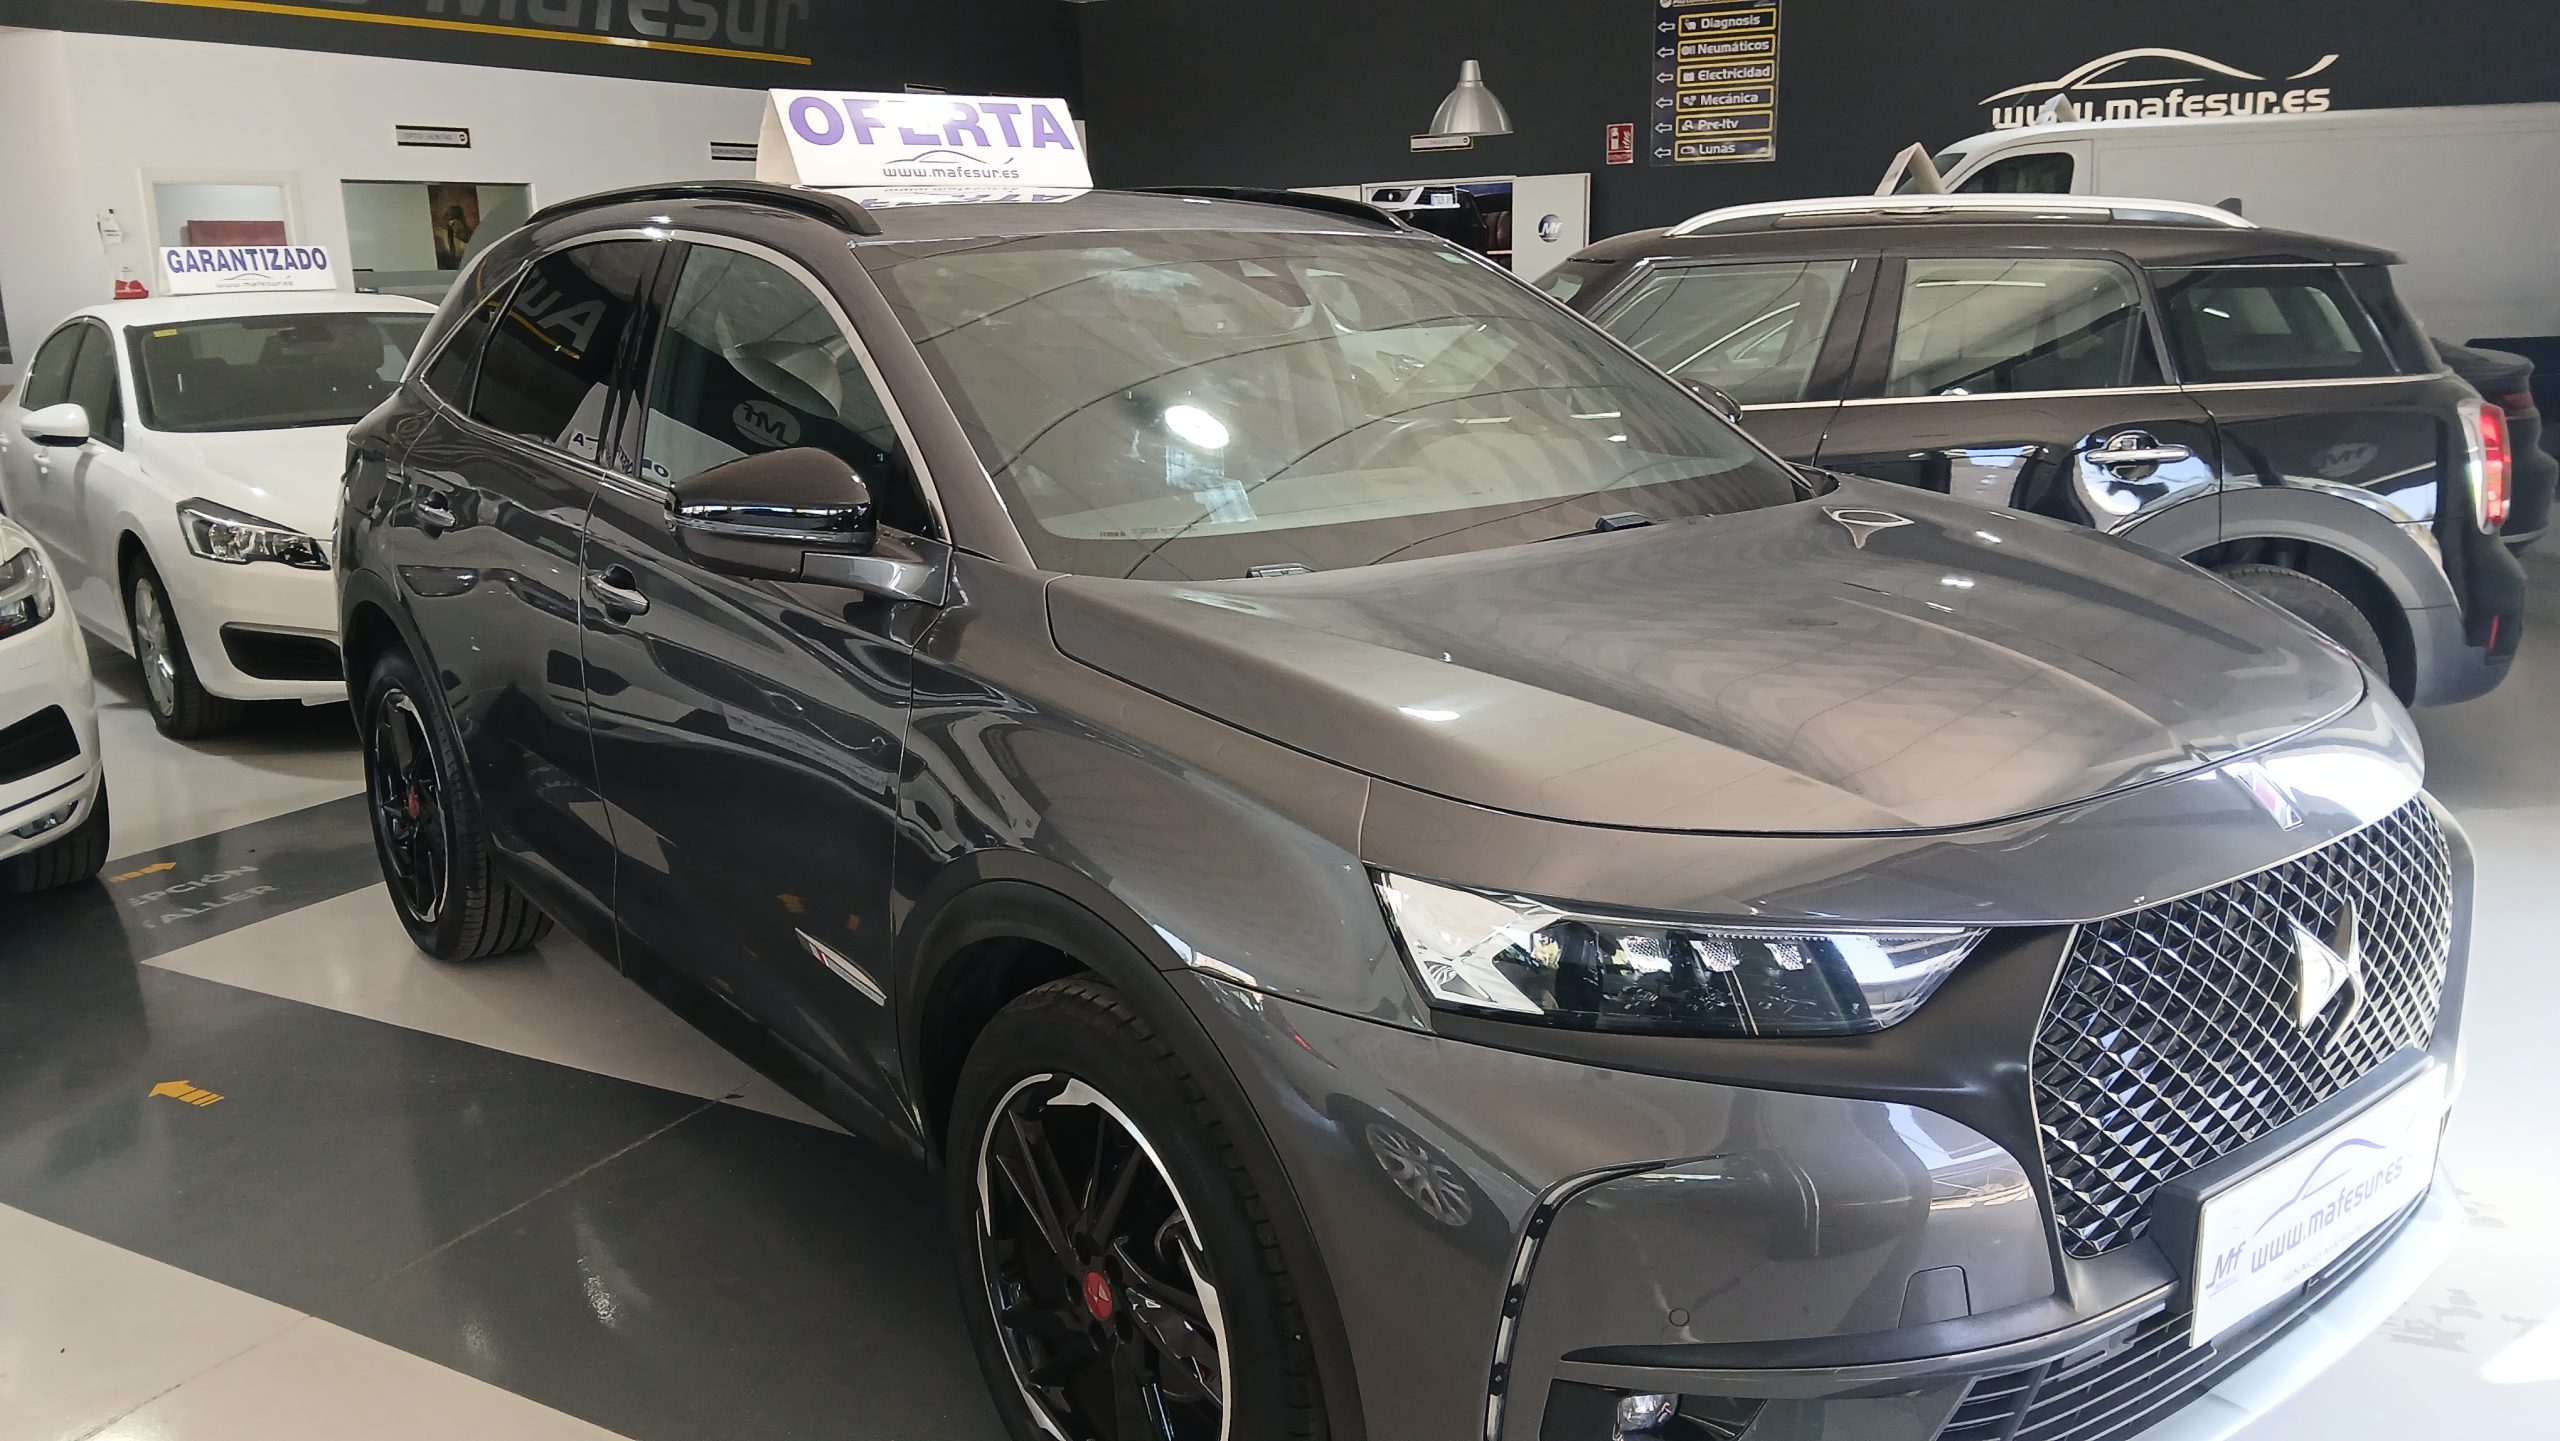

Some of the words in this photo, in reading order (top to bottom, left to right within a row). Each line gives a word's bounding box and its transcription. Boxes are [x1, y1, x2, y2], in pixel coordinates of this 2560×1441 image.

[426, 0, 808, 49] aesur
[1701, 15, 1761, 29] Diagnosis
[1698, 40, 1770, 55] Neumáticos
[1698, 66, 1771, 81] Electricidad
[1700, 92, 1759, 106] Mecánica
[1699, 143, 1736, 155] Lunas
[883, 166, 1019, 179] www.mafesur.es
[167, 248, 327, 273] GARANTIZADO
